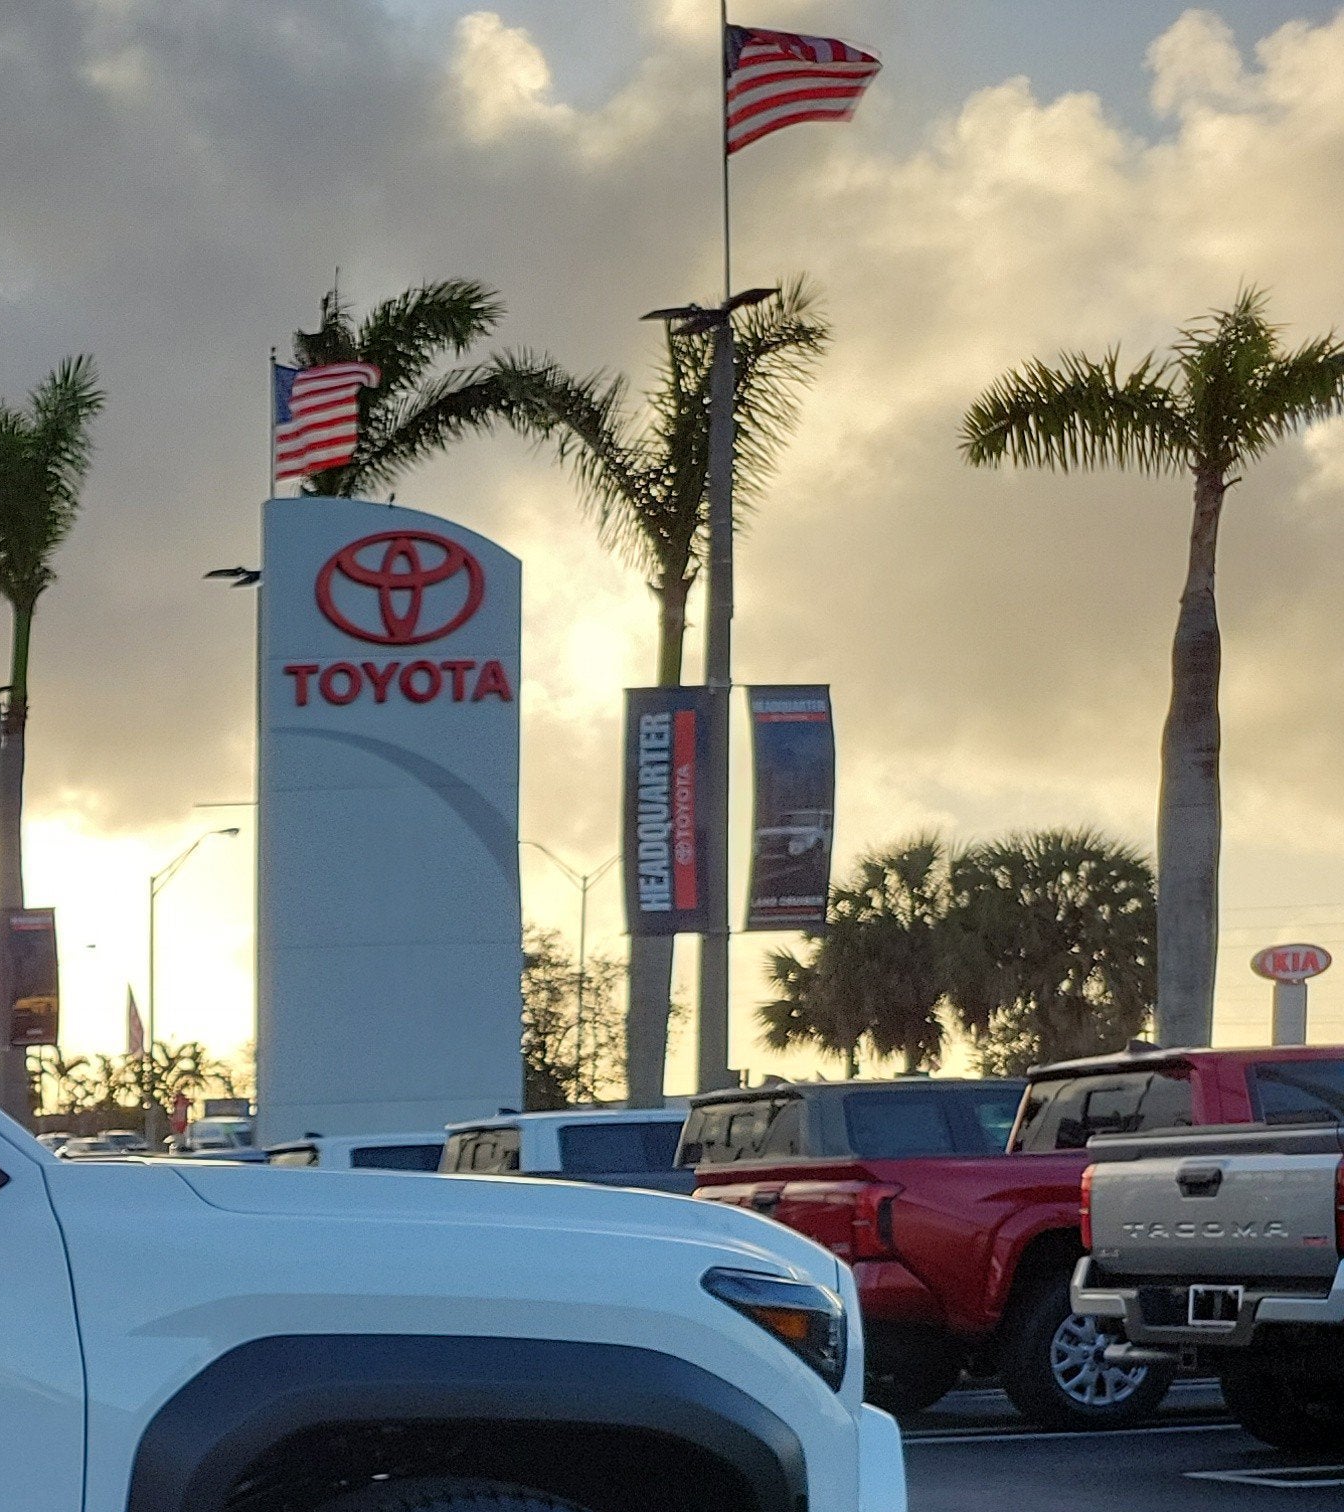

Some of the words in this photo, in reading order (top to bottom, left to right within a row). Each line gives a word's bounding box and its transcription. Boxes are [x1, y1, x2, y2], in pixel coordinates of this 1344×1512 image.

[283, 659, 514, 707] TOYOTA
[637, 711, 673, 912] HEADQUARTER
[1272, 950, 1321, 972] KIA
[1123, 1219, 1289, 1239] TACOMA
